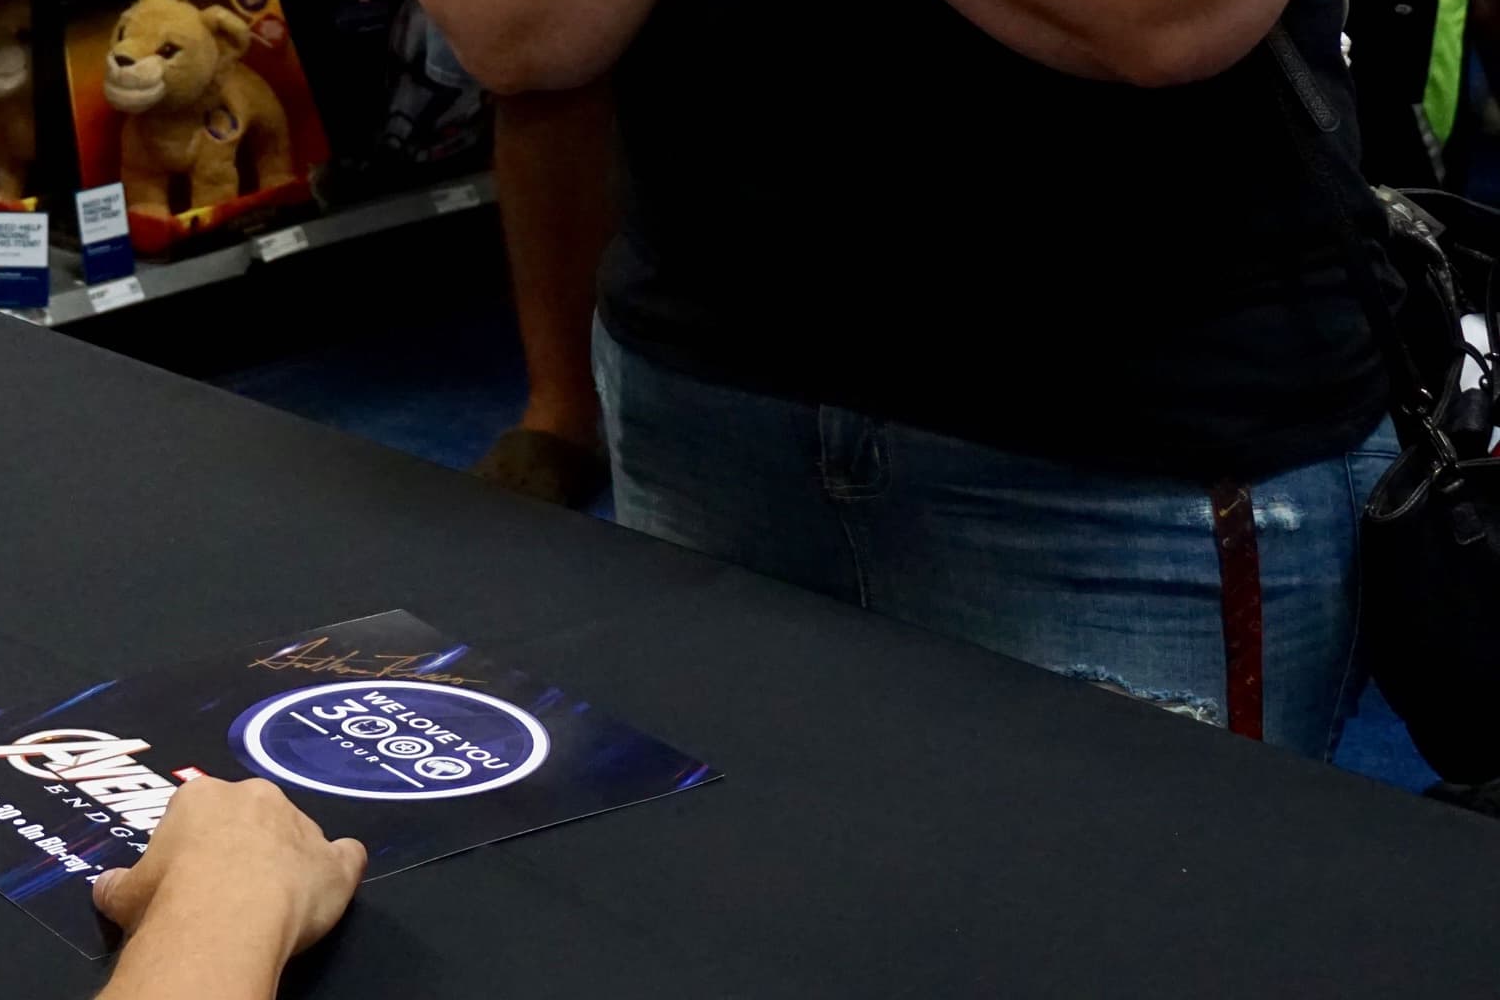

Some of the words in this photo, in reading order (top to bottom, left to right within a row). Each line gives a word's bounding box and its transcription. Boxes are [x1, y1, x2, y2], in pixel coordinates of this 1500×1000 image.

[18, 223, 43, 232] HELP
[329, 734, 381, 765] TOUR
[362, 690, 402, 714] WE
[395, 711, 463, 745] LOVE
[454, 740, 510, 771] YOU
[44, 783, 150, 853] ENDGA
[17, 823, 45, 841] On
[34, 833, 93, 873] Blu-ray
